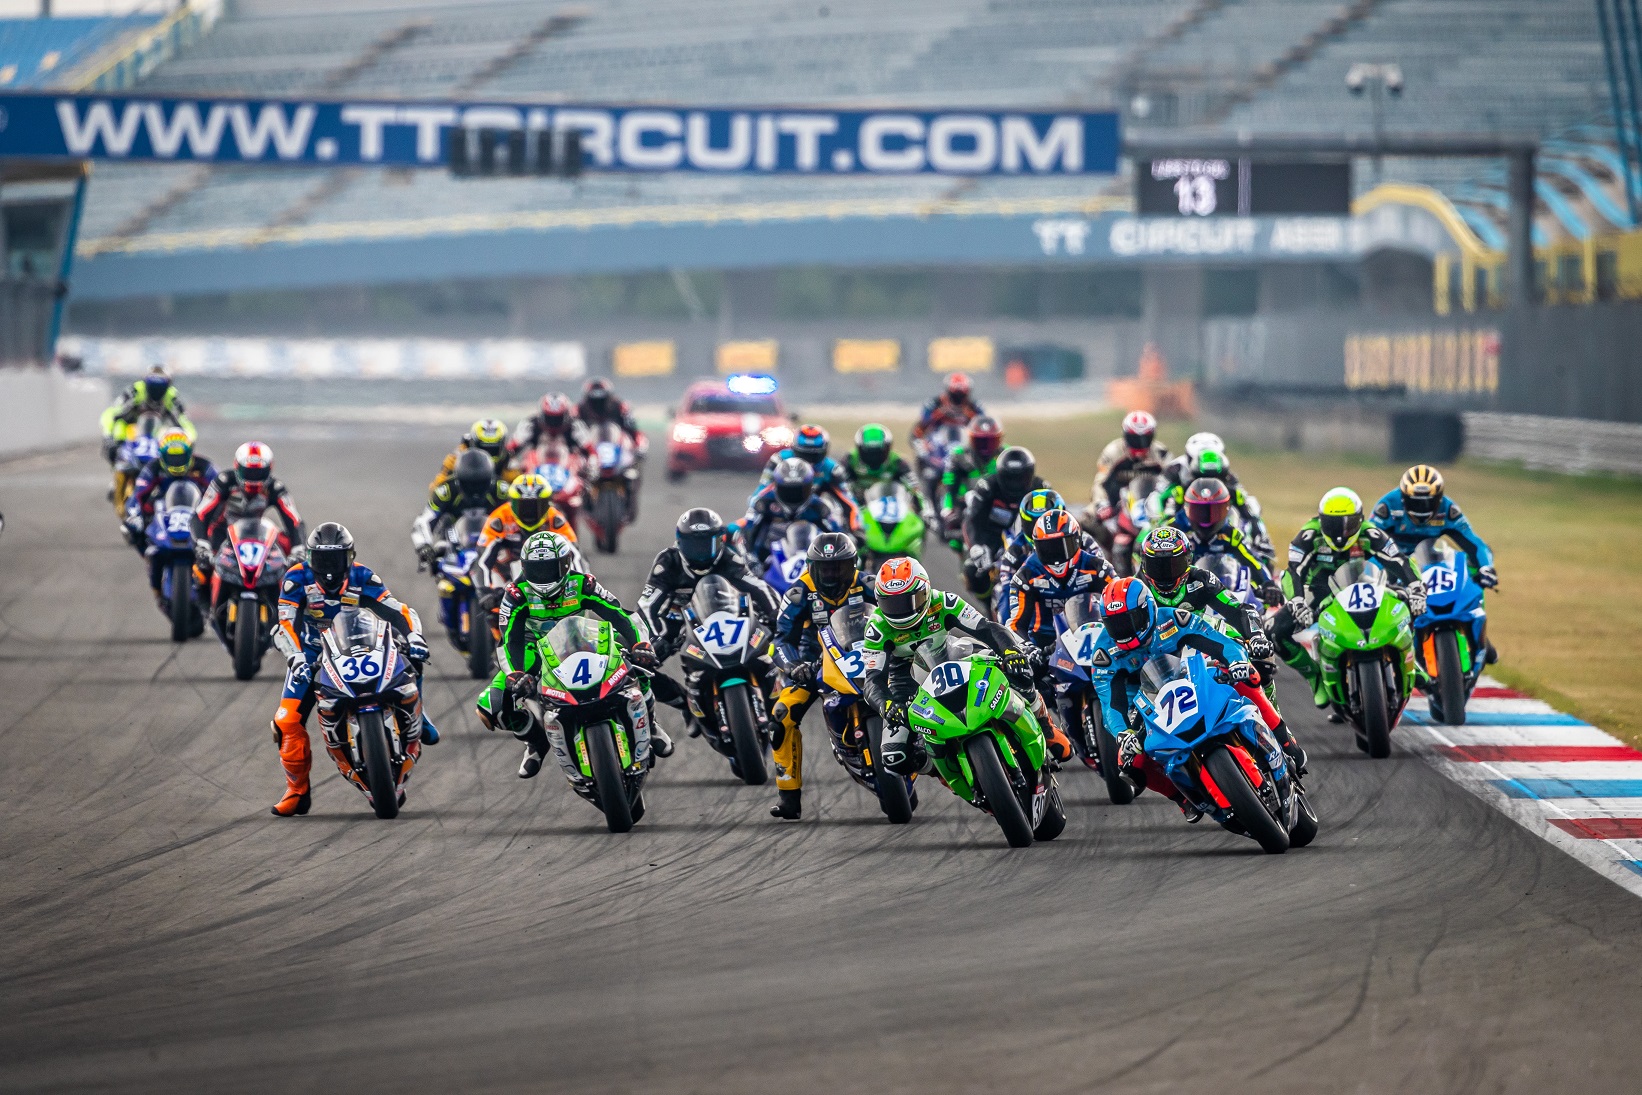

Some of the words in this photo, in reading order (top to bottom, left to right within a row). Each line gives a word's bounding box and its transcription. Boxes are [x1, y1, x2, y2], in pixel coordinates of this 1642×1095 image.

[1033, 219, 1092, 255] TT
[1426, 568, 1454, 593] 45
[807, 592, 818, 600] 26
[1107, 602, 1123, 611] Arai
[1348, 583, 1377, 609] 43
[704, 619, 745, 647] 47
[342, 655, 380, 681] 36
[571, 658, 592, 685] 4
[608, 667, 626, 686] MOTUL
[931, 662, 965, 696] 30
[545, 688, 566, 700] MOTUL
[990, 689, 1003, 710] SALCO
[1160, 686, 1197, 727] 72
[914, 725, 931, 735] SALCO
